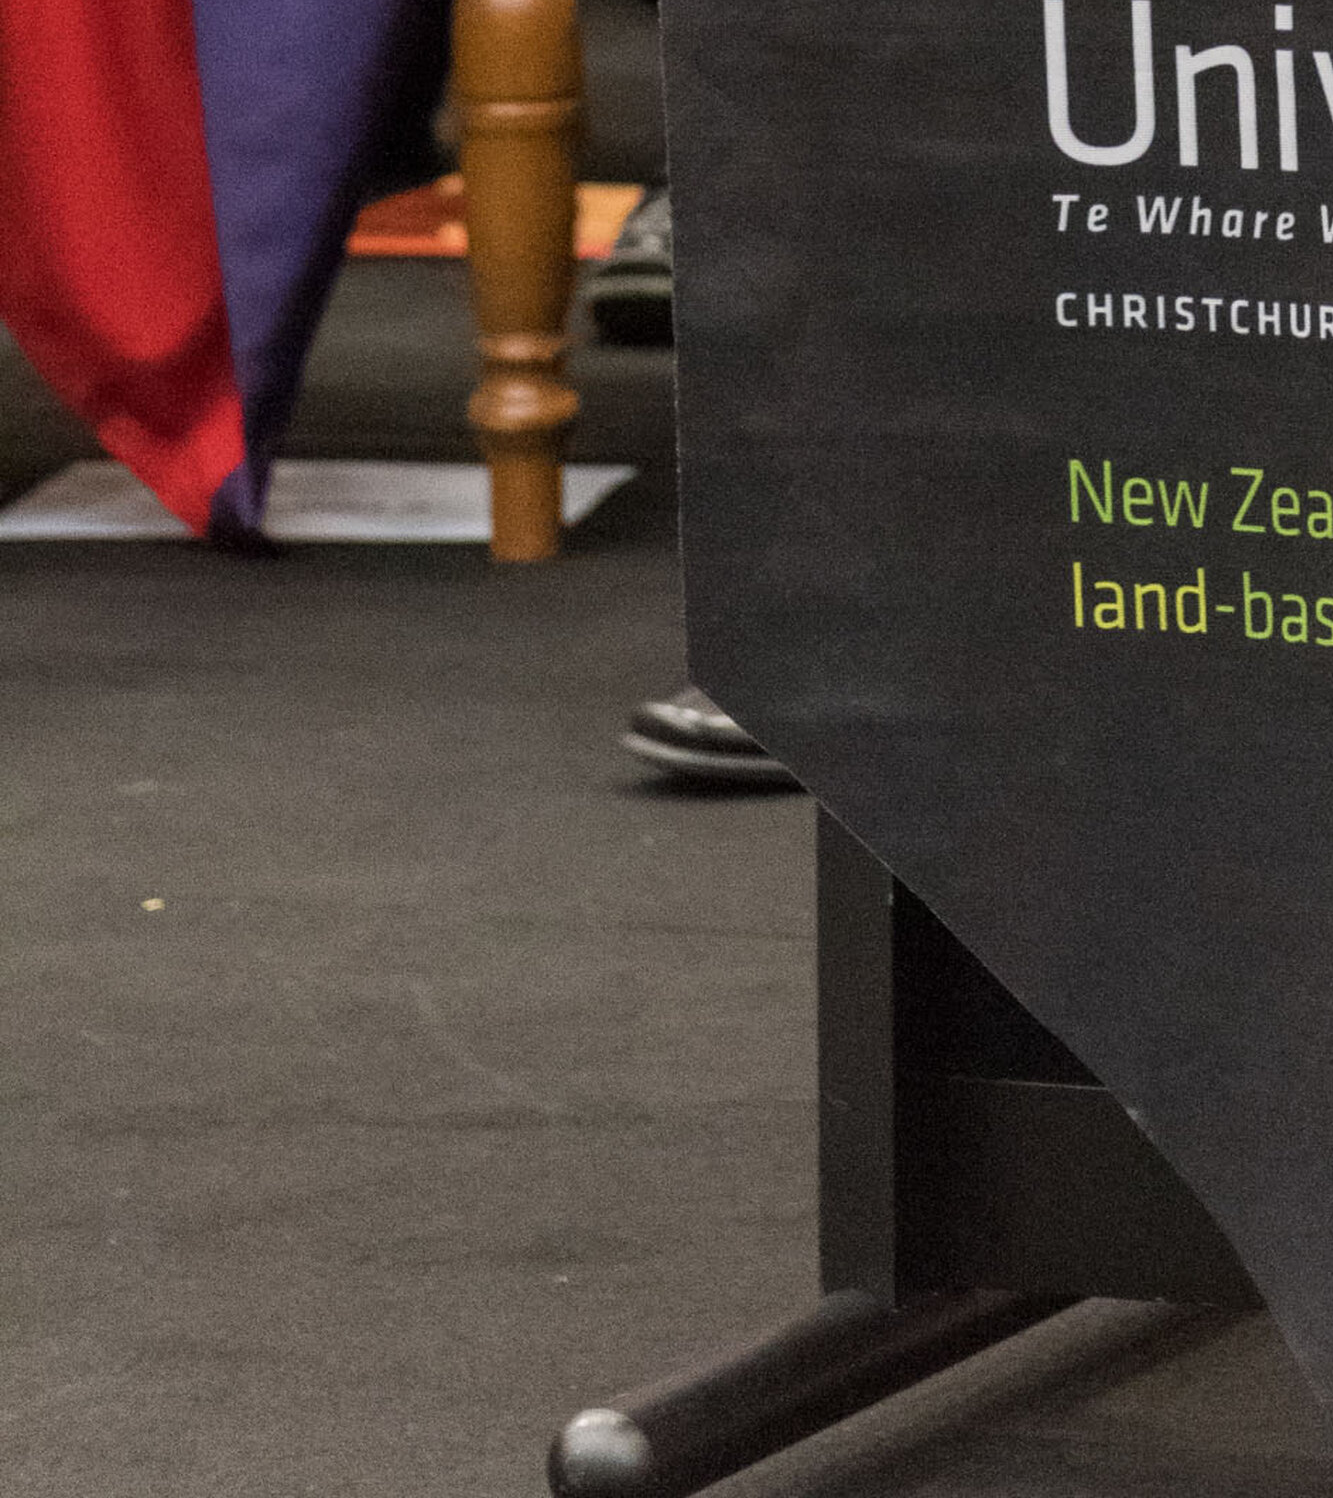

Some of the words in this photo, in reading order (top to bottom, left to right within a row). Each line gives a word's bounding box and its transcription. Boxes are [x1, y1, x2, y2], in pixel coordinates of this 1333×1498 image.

[1051, 192, 1109, 233] Te
[1136, 194, 1297, 242] Whare
[1069, 458, 1210, 530] New
